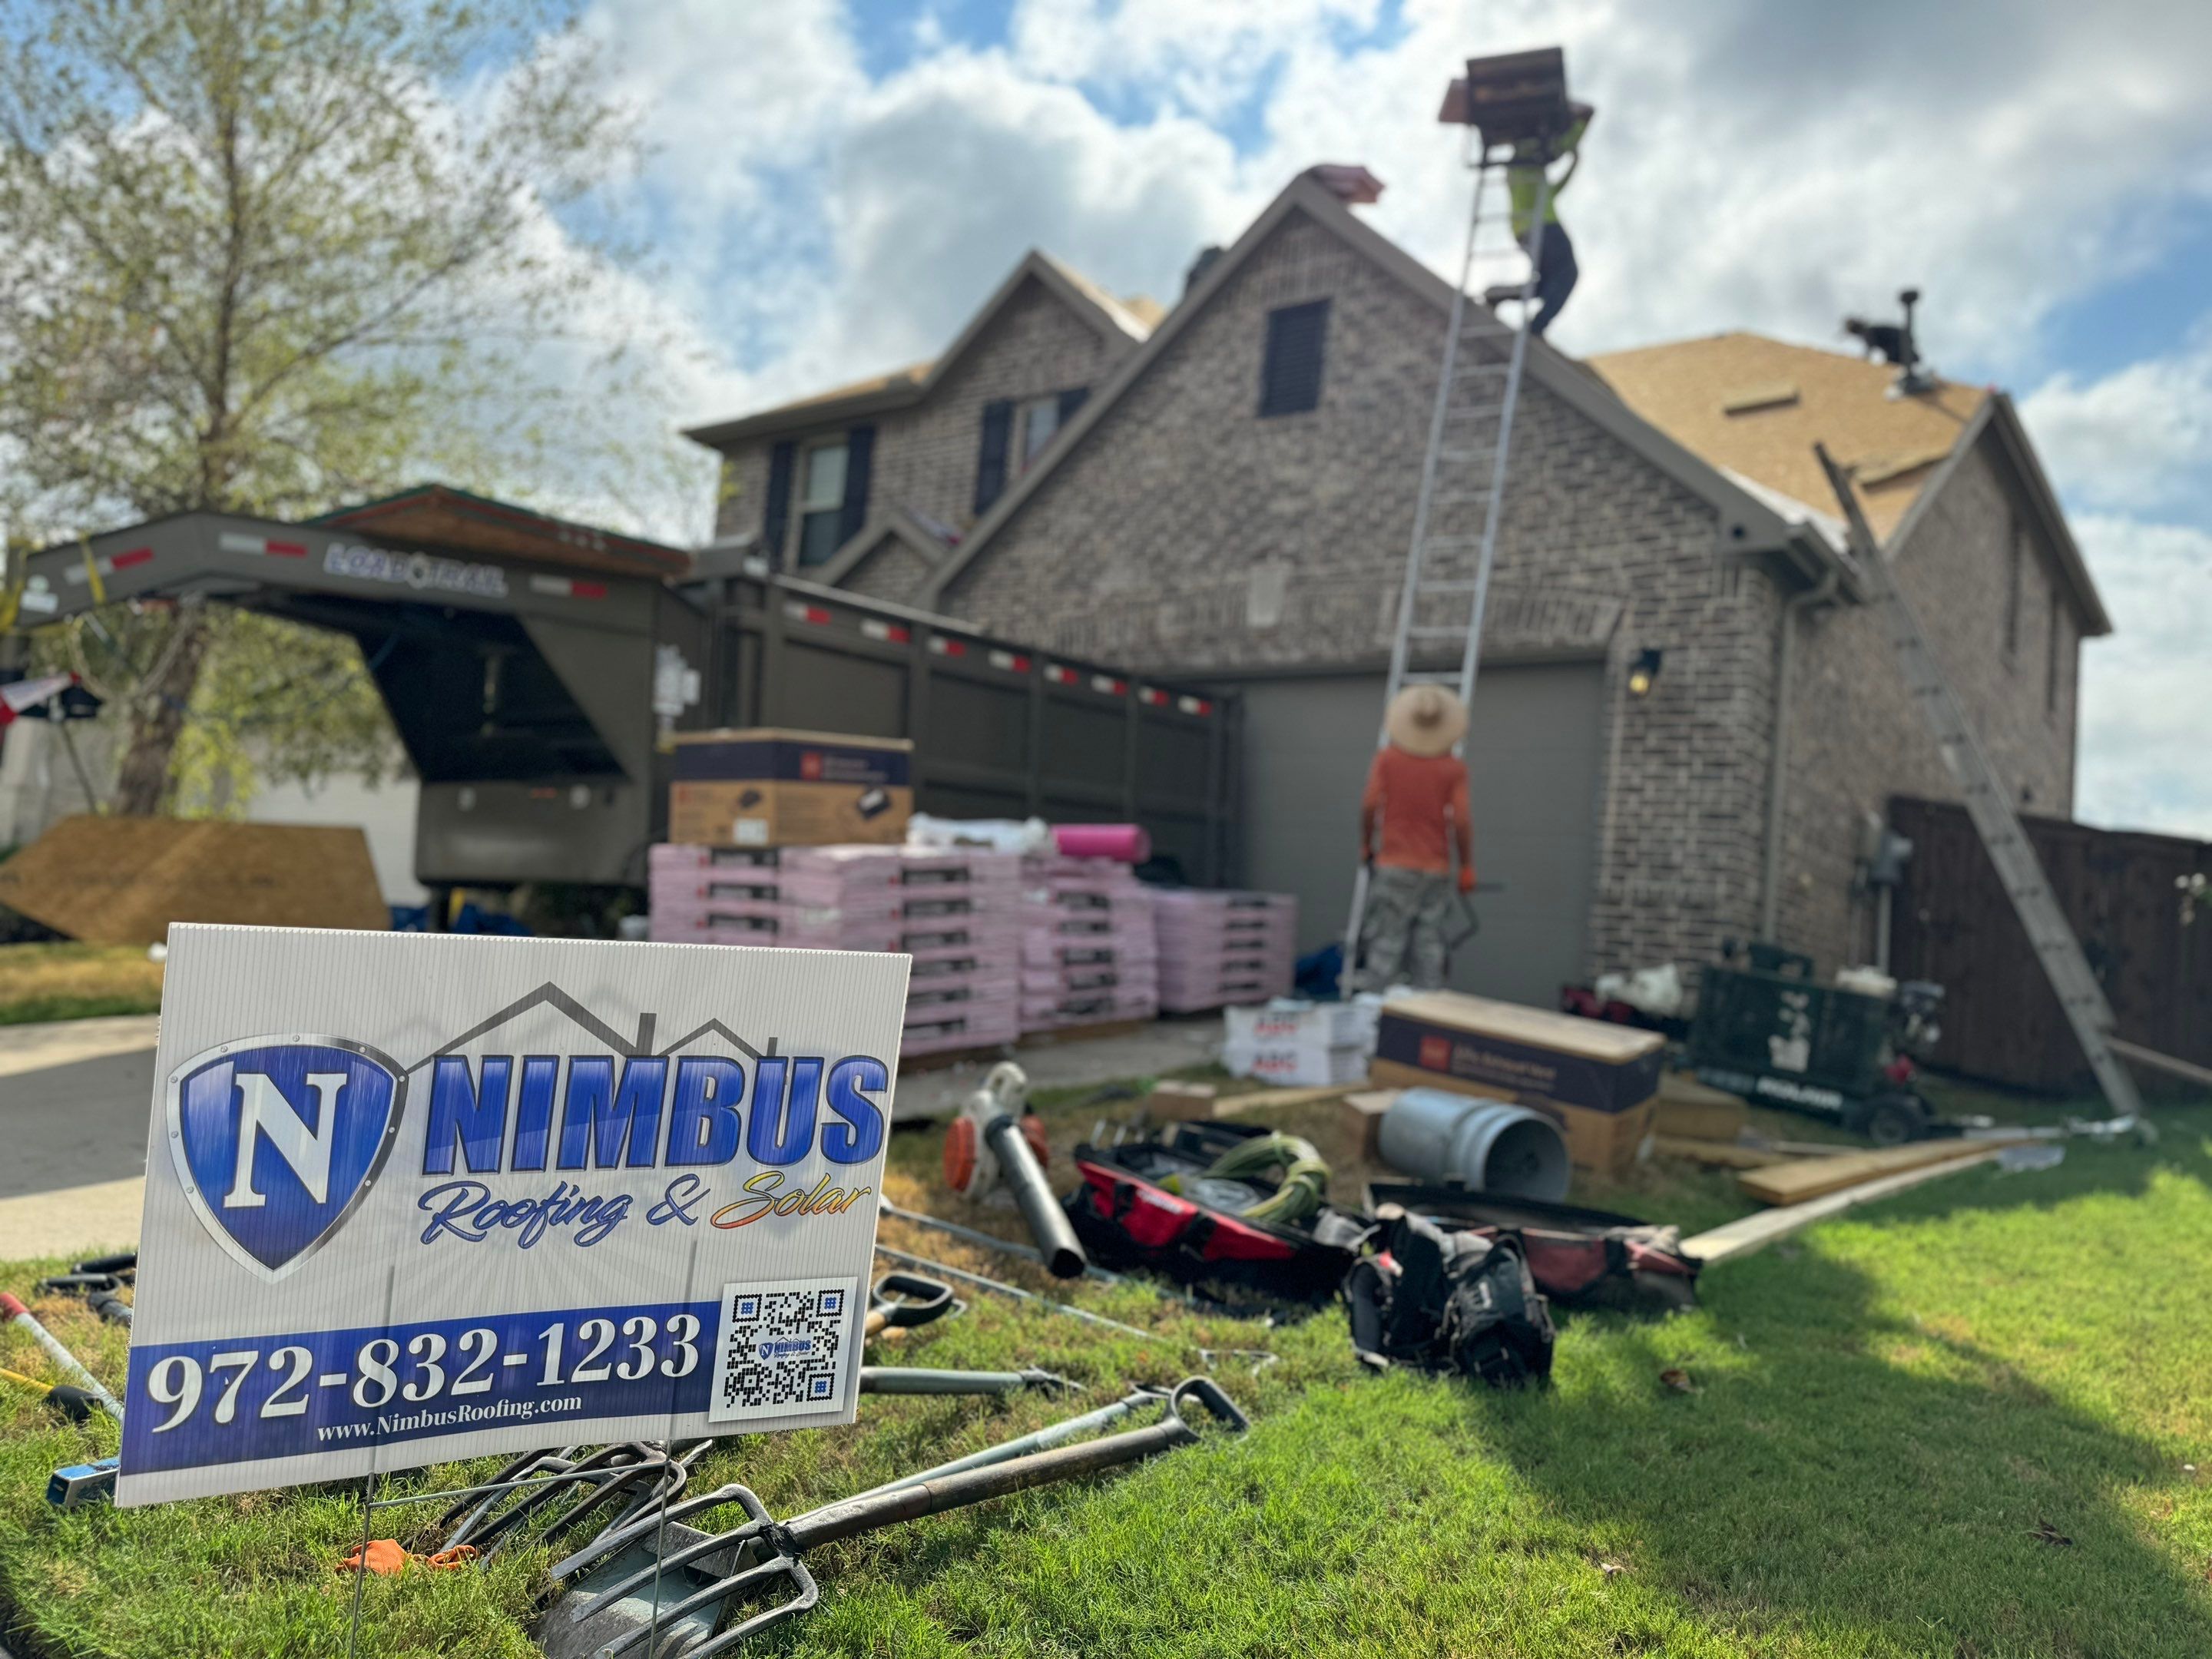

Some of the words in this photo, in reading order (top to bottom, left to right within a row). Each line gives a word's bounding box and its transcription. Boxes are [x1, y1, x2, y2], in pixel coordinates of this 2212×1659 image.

[223, 1071, 347, 1209] N
[422, 1054, 889, 1176] NIMBUS
[417, 1179, 634, 1250] Roofing
[645, 1173, 711, 1227] &
[710, 1170, 872, 1230] Solar
[146, 1313, 702, 1434] 972-832-1233
[773, 1339, 812, 1353] NIMBUS
[317, 1396, 582, 1442] www.NimbusRoofing.com
